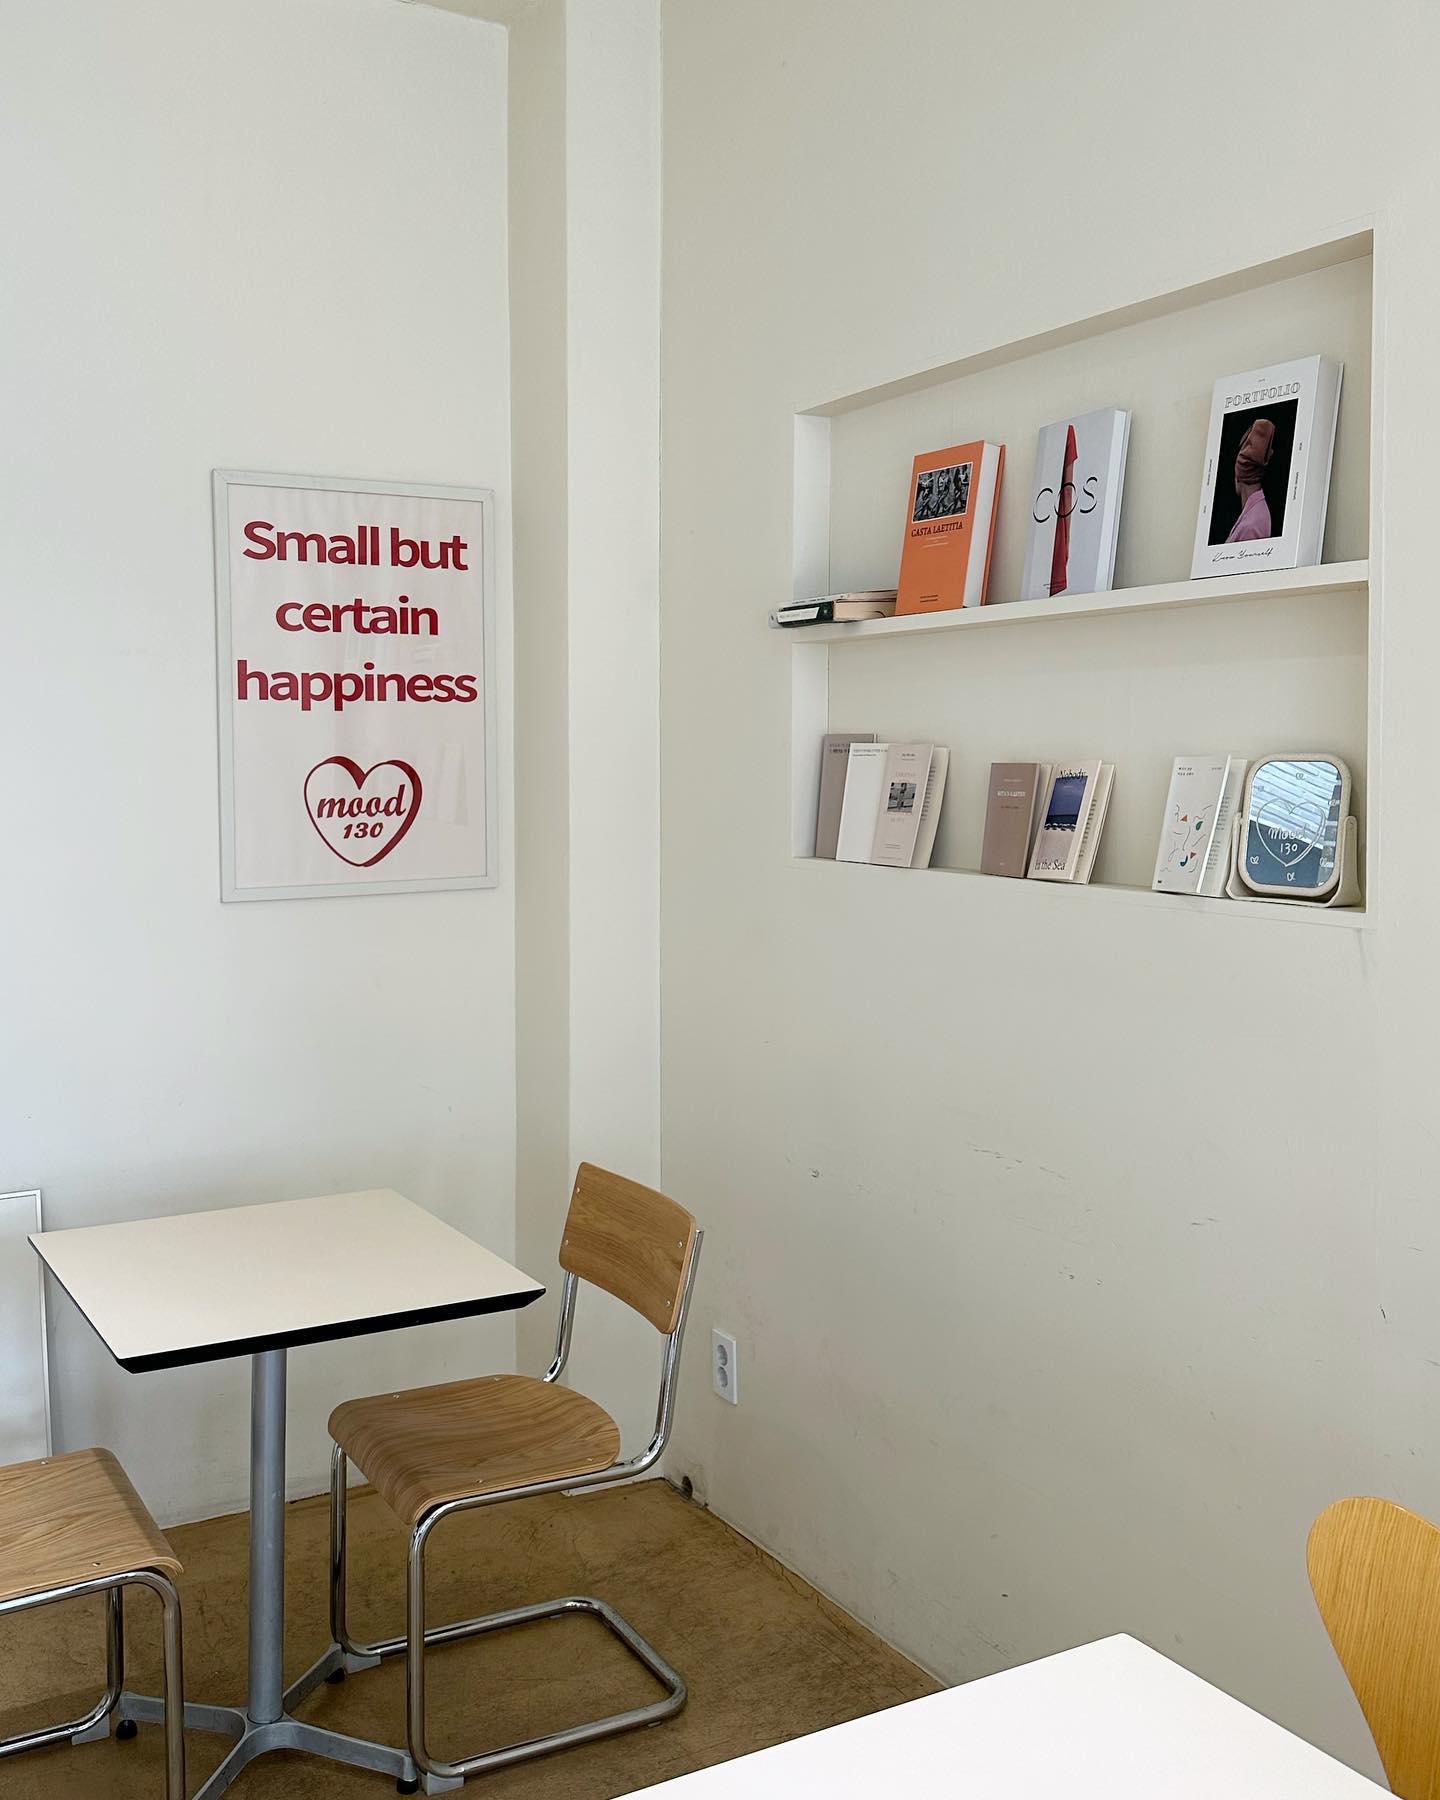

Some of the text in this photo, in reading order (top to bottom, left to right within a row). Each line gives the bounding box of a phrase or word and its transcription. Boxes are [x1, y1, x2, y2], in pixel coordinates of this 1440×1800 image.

[1225, 382, 1301, 409] PORTFOLIO
[1033, 476, 1098, 523] COS
[911, 527, 932, 538] CASTA
[933, 521, 964, 534] LAETITIA
[243, 520, 468, 571] Small but
[276, 595, 439, 636] certain
[237, 659, 478, 711] happiness
[1060, 768, 1086, 781] Nobody
[317, 783, 406, 819] mood
[343, 822, 384, 840] 130
[1280, 842, 1298, 855] 130
[1041, 859, 1051, 870] the
[1052, 859, 1066, 870] Sea
